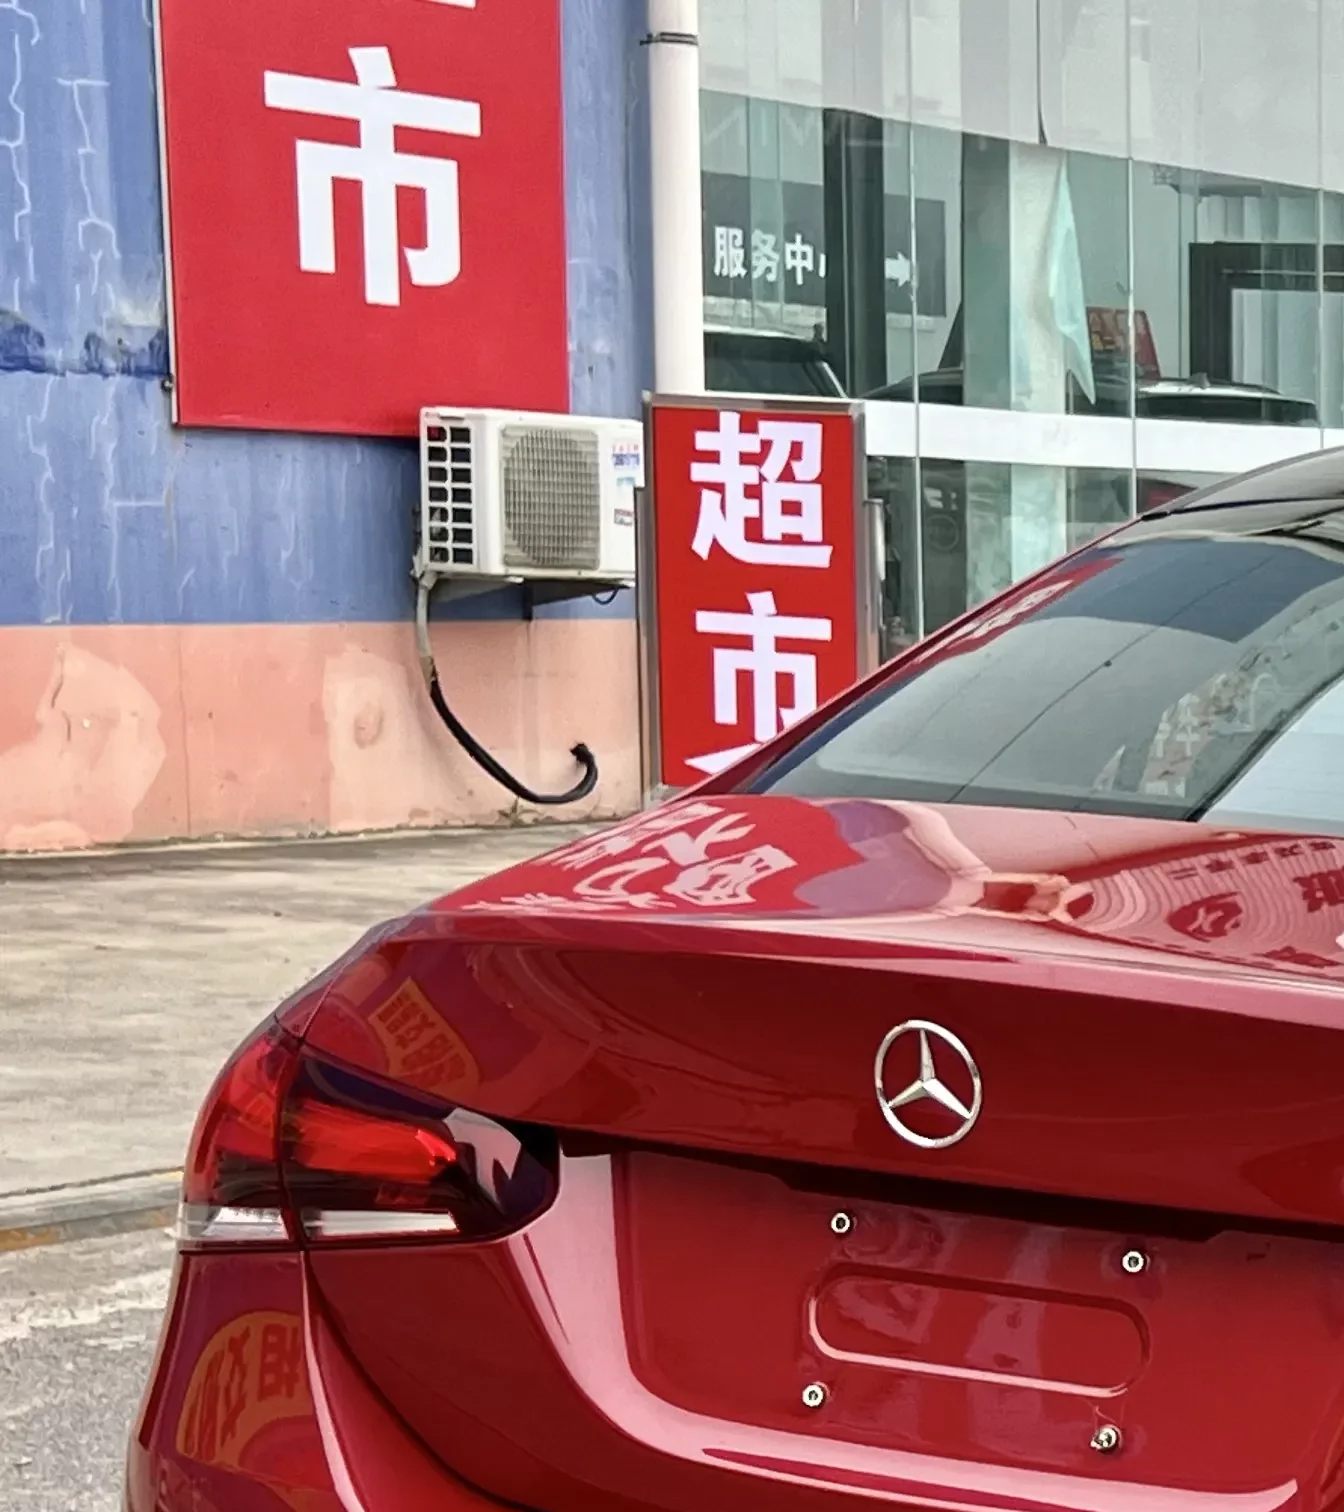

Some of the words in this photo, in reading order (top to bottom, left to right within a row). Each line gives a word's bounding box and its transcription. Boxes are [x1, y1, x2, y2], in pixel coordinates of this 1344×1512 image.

[264, 0, 482, 306] 市
[713, 224, 826, 286] 服务中
[690, 411, 833, 733] 超市
